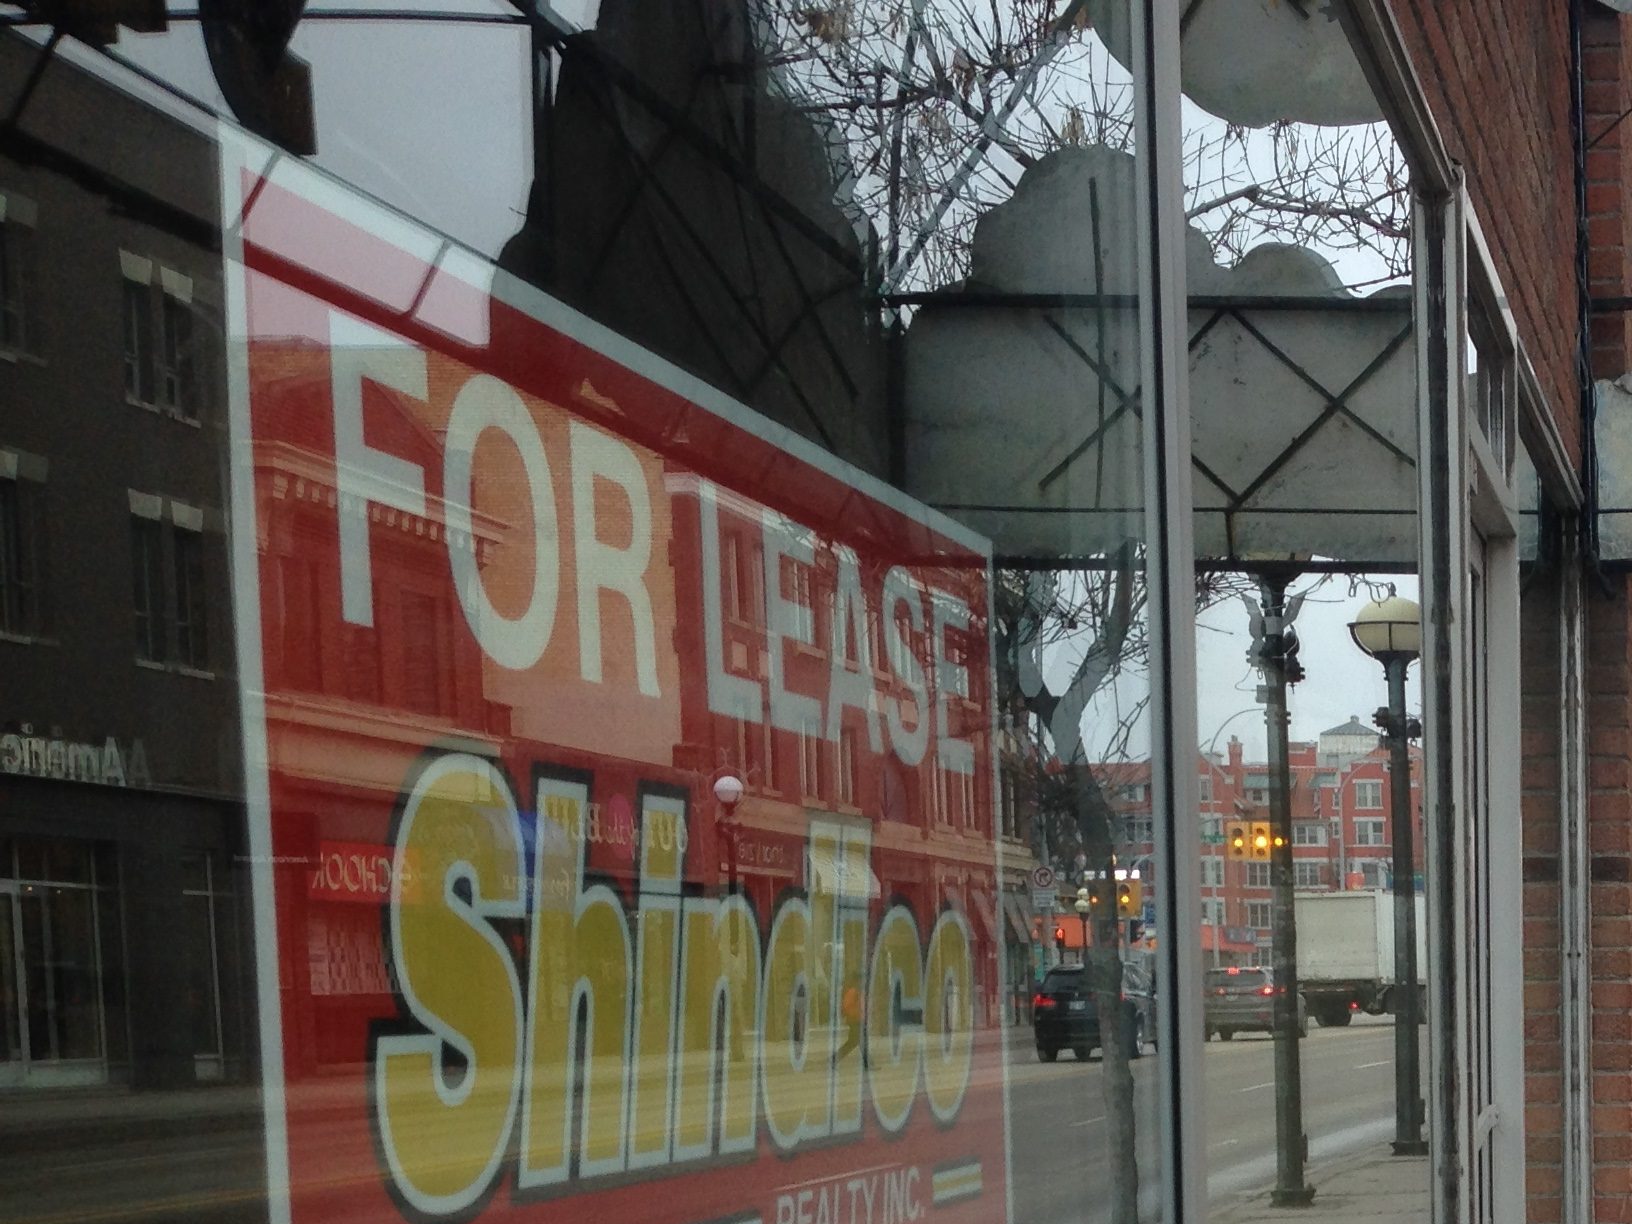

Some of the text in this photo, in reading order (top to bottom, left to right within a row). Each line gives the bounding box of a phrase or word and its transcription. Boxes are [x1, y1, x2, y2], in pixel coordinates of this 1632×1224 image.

[327, 309, 977, 776] FOR LEASE
[370, 748, 976, 1217] Shindico
